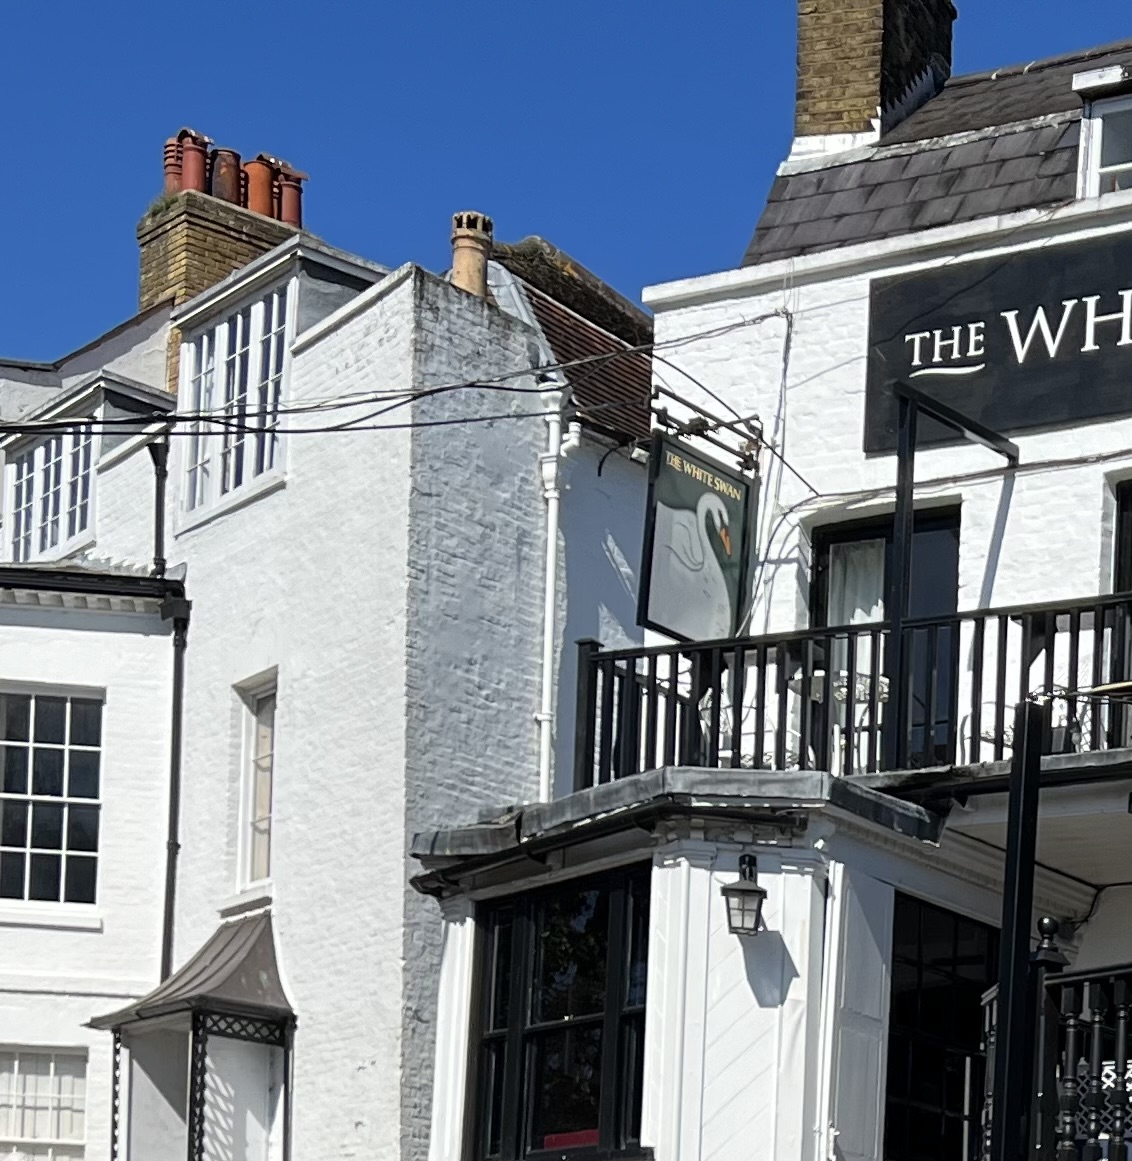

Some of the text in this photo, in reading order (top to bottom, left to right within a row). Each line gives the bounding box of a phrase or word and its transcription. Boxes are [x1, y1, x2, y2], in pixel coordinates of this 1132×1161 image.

[904, 322, 985, 367] THE
[666, 450, 742, 501] THE WHITE SWAN
